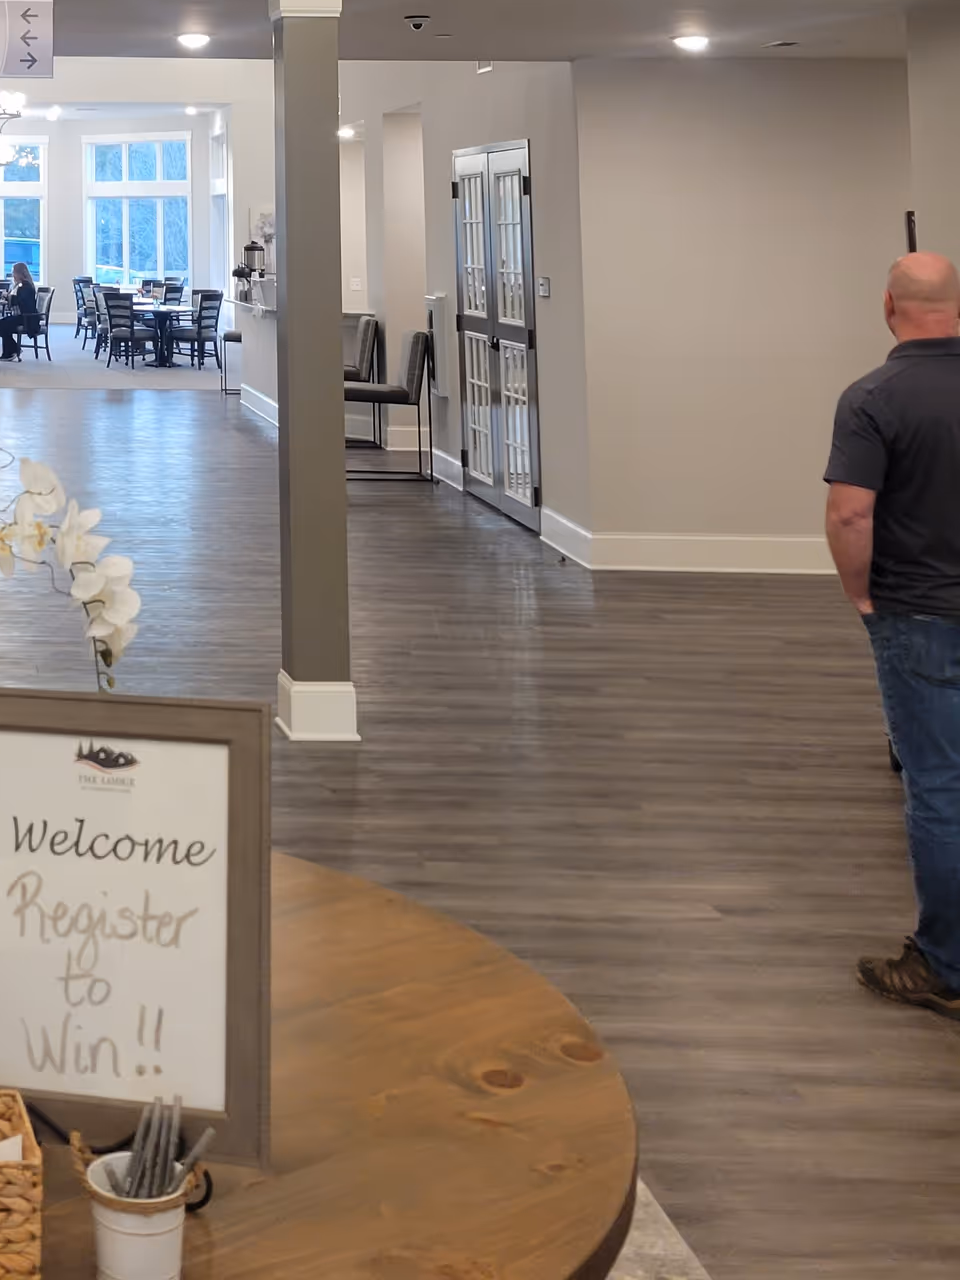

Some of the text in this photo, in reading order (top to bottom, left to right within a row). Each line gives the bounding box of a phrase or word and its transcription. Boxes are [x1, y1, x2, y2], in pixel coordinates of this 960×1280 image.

[12, 815, 217, 868] Welcome
[6, 870, 200, 969] Register
[56, 949, 112, 1008] to
